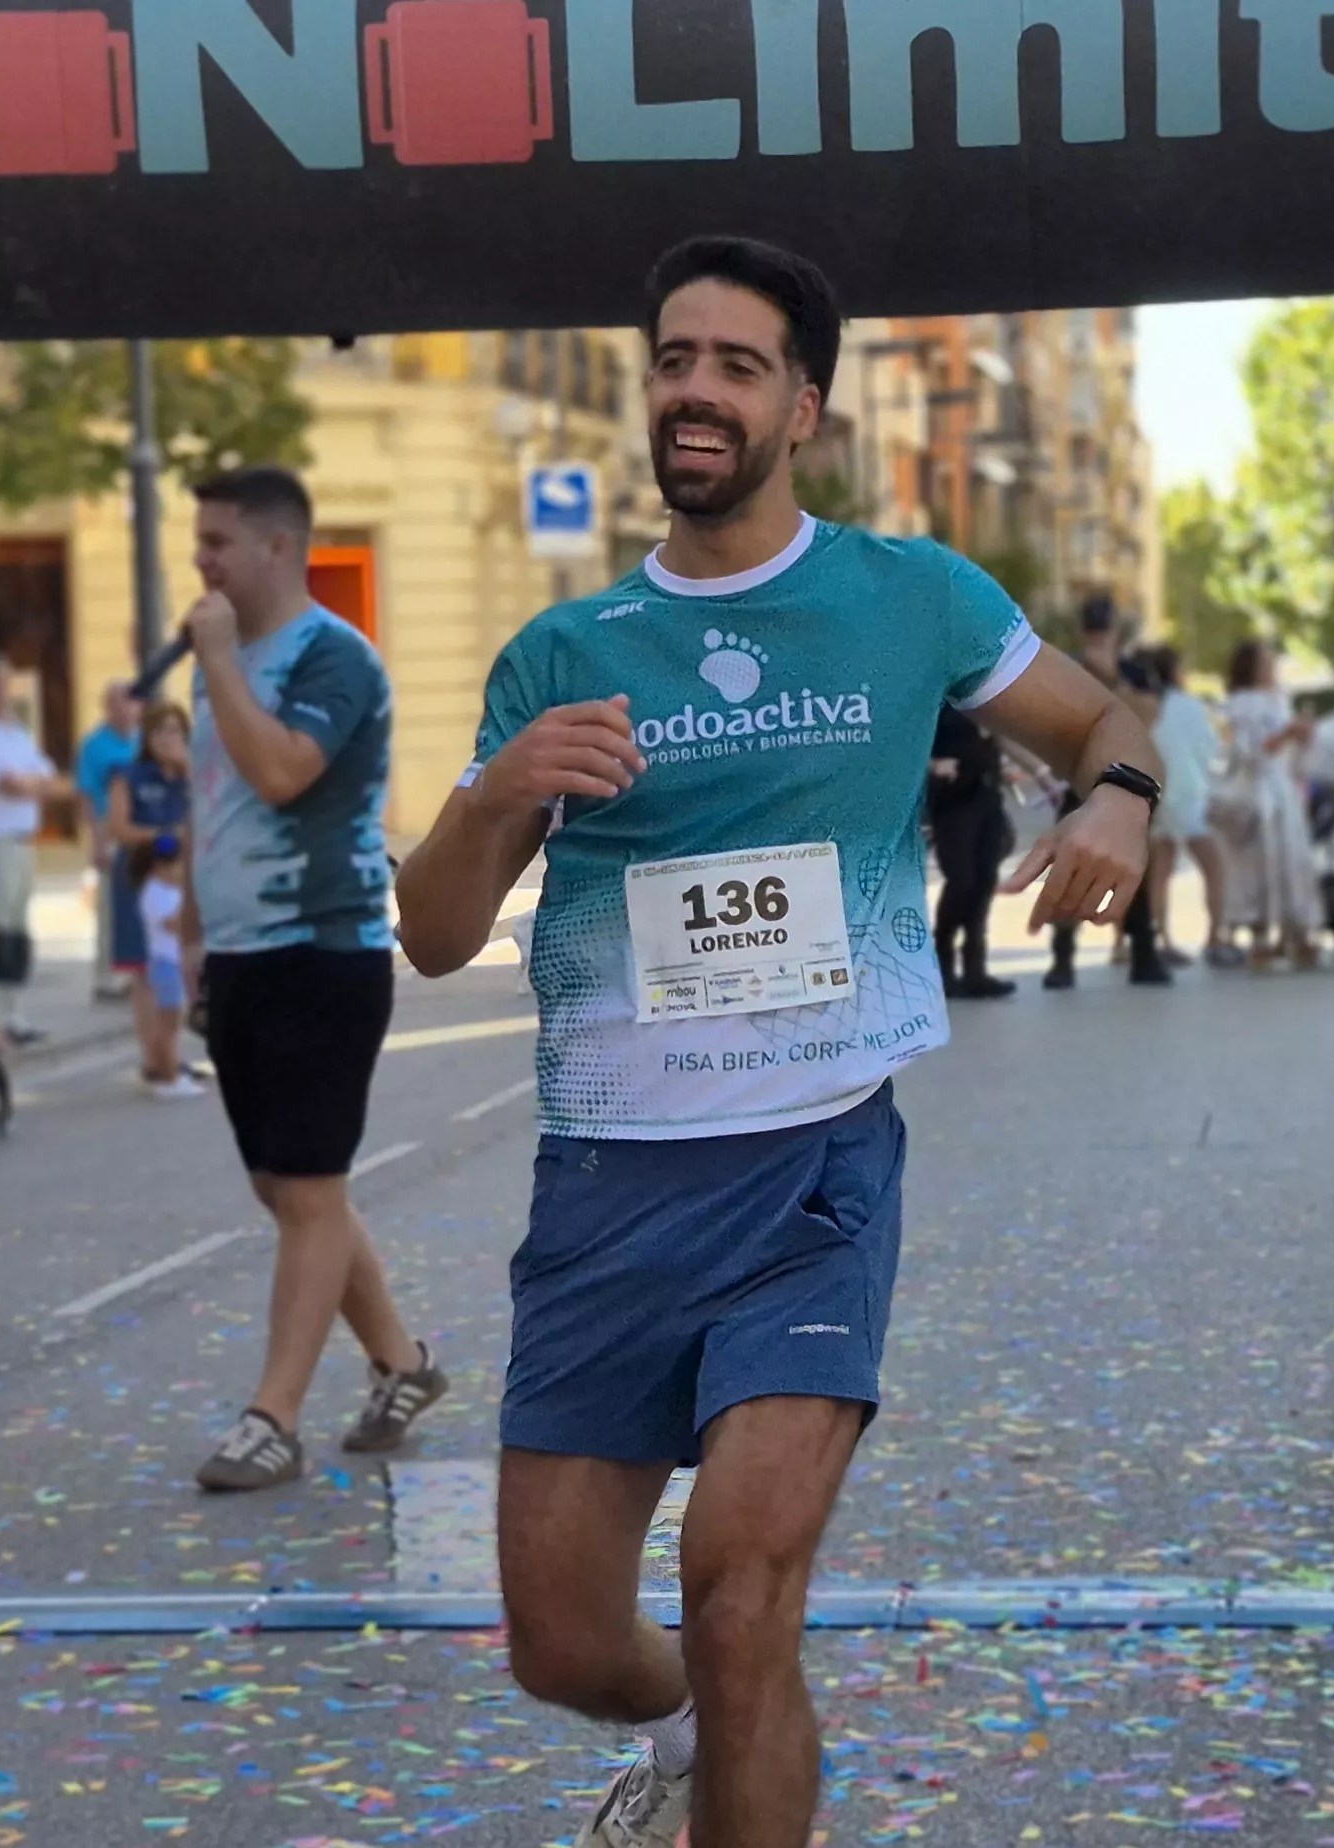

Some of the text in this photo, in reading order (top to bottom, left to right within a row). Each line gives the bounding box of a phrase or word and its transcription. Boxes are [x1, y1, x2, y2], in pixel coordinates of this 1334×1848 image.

[746, 739, 755, 752] Y
[682, 876, 789, 930] 136
[690, 928, 788, 954] LORENZO
[665, 1053, 714, 1072] PISA
[722, 1049, 780, 1072] BIEN,
[863, 1013, 932, 1050] MEJOR
